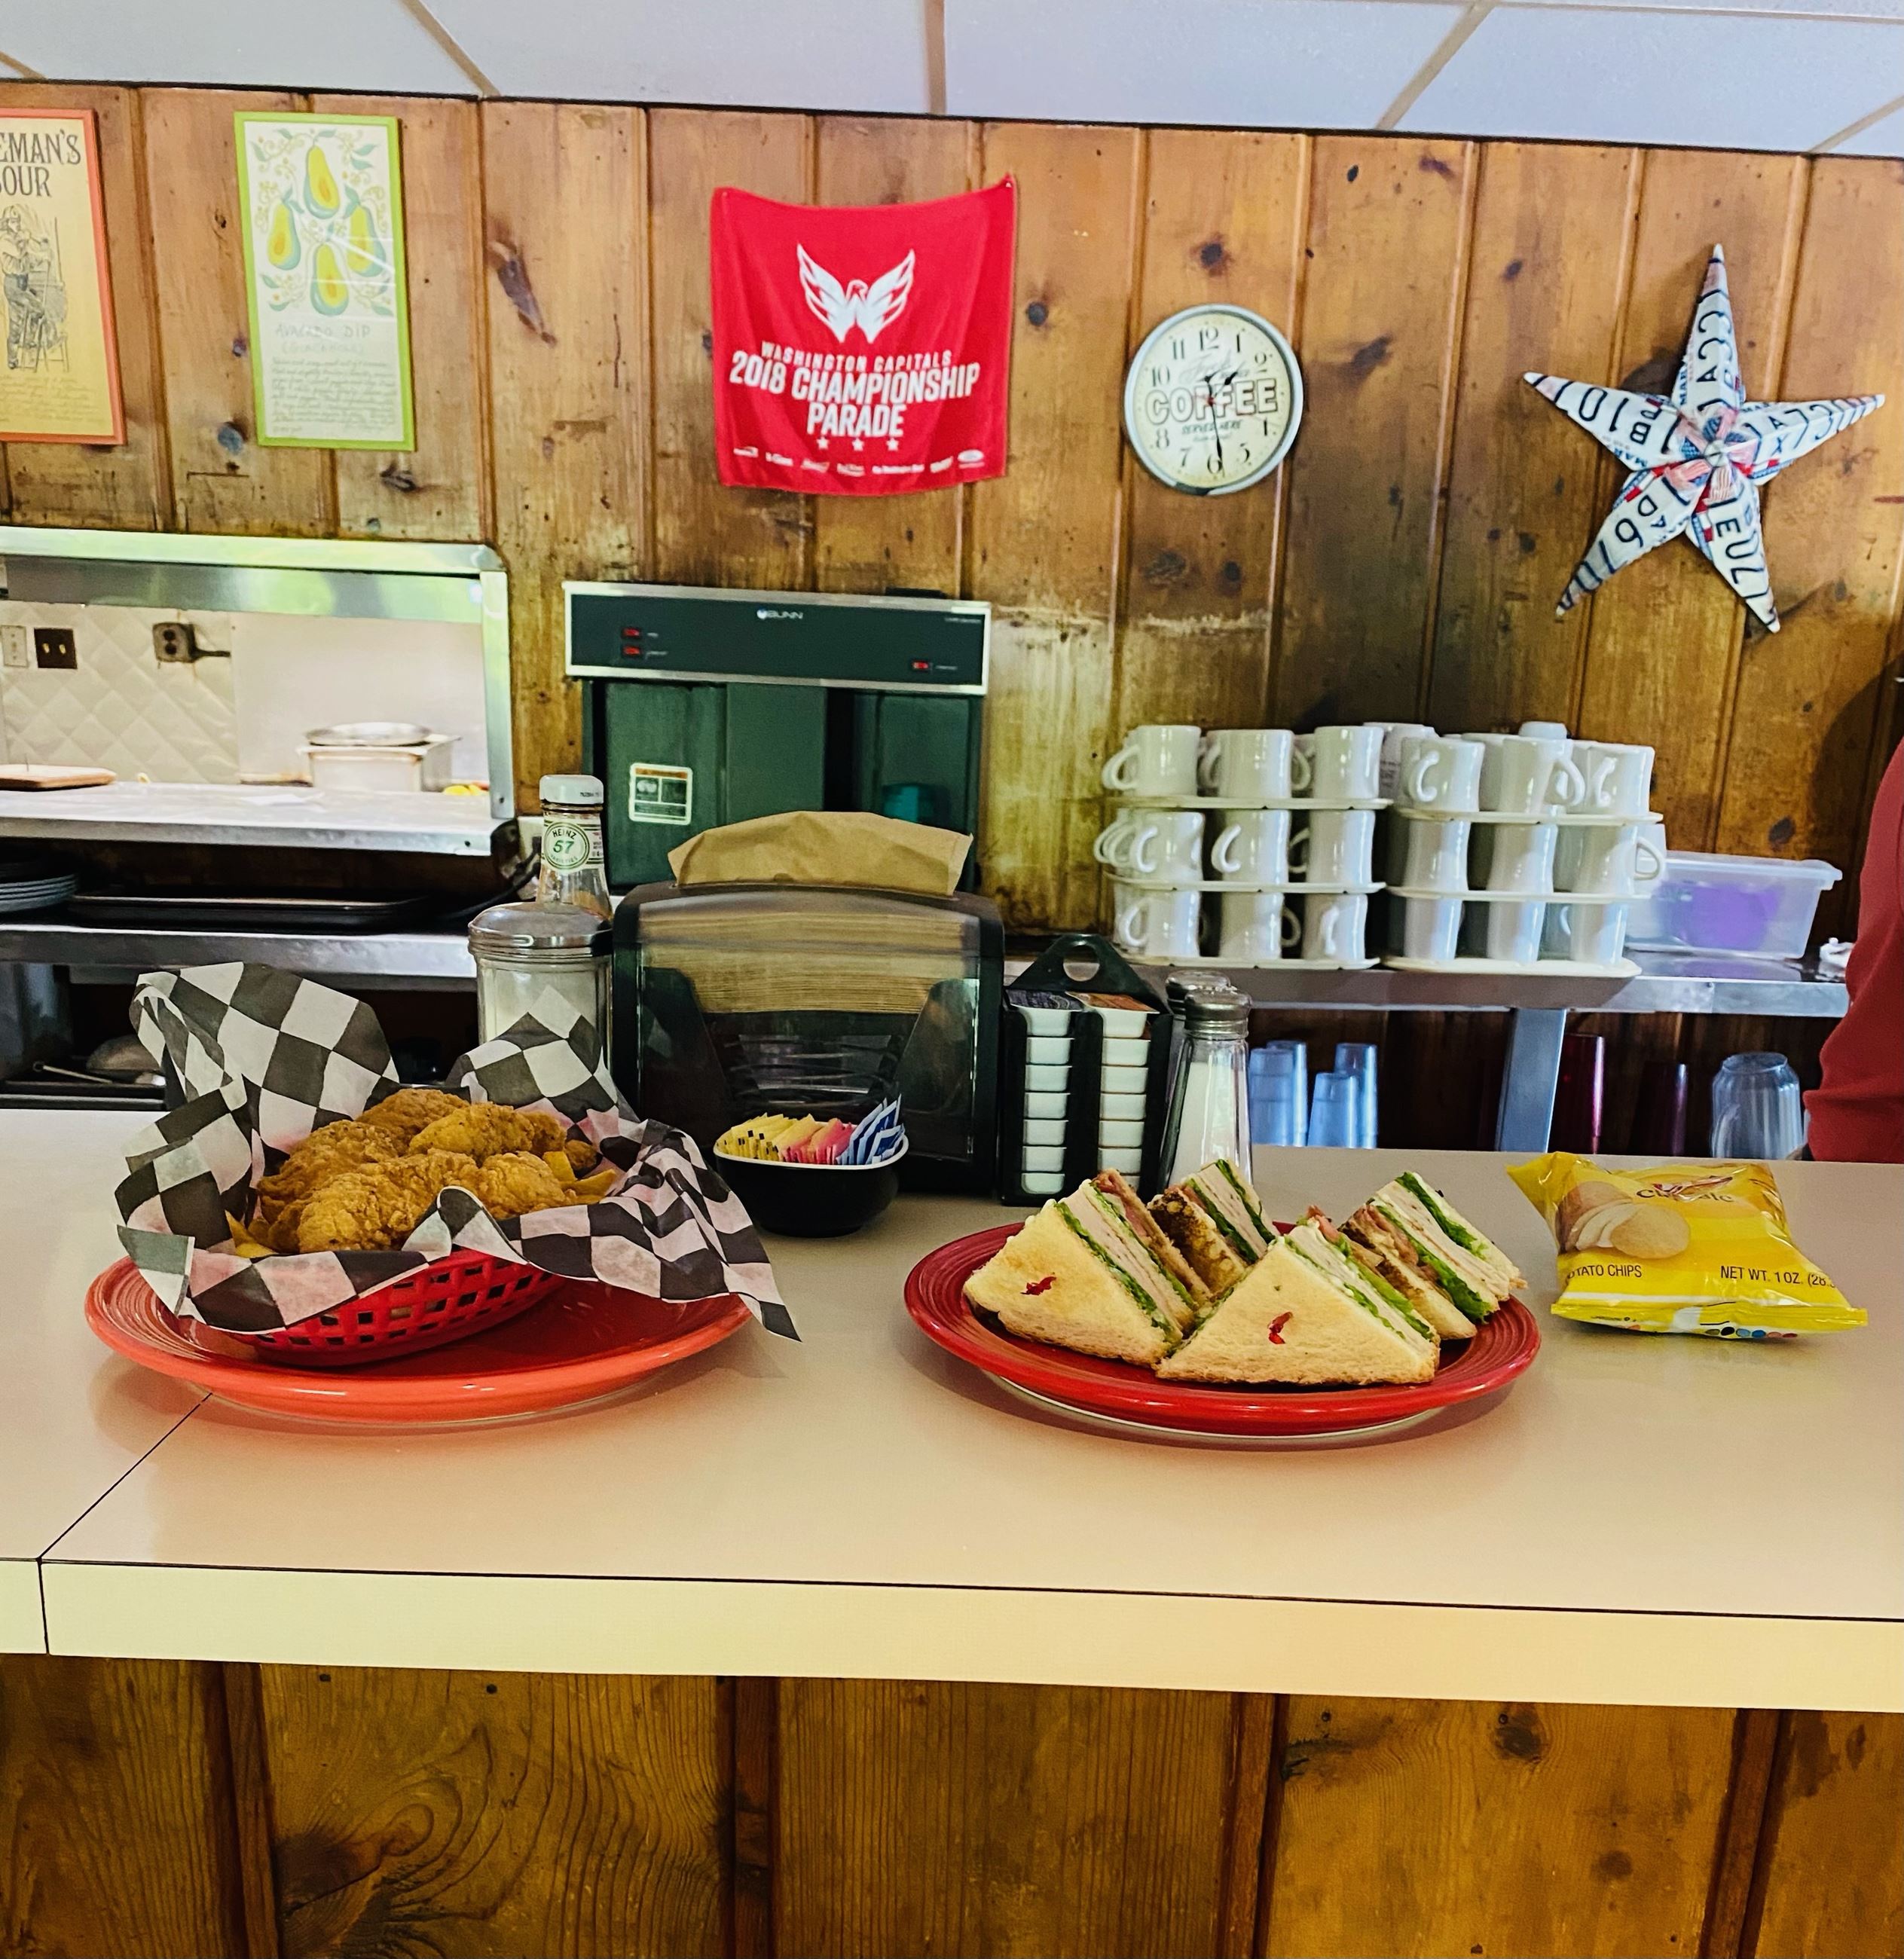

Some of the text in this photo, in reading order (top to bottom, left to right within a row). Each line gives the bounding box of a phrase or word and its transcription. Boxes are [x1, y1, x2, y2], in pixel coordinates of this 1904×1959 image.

[0, 165, 52, 197] OUR
[344, 324, 371, 338] DIP
[1199, 326, 1219, 351] 12
[1172, 340, 1185, 359] 11
[1236, 333, 1241, 353] 1
[761, 341, 952, 371] WASHINGTON CAPITALS
[729, 350, 980, 405] 2018 CHAMPIONSHIP
[1152, 364, 1170, 387] 10
[1145, 377, 1278, 426] COFFEE
[807, 402, 907, 437] PARADE
[1156, 427, 1169, 449] 8
[1181, 447, 1191, 467] 7
[1207, 454, 1223, 474] 6
[767, 610, 803, 619] BUNN
[552, 829, 576, 839] HEINZ
[553, 840, 574, 854] 57
[1607, 1264, 1643, 1278] CHIPS
[1721, 1266, 1744, 1279] NET
[1748, 1269, 1771, 1282] WT.
